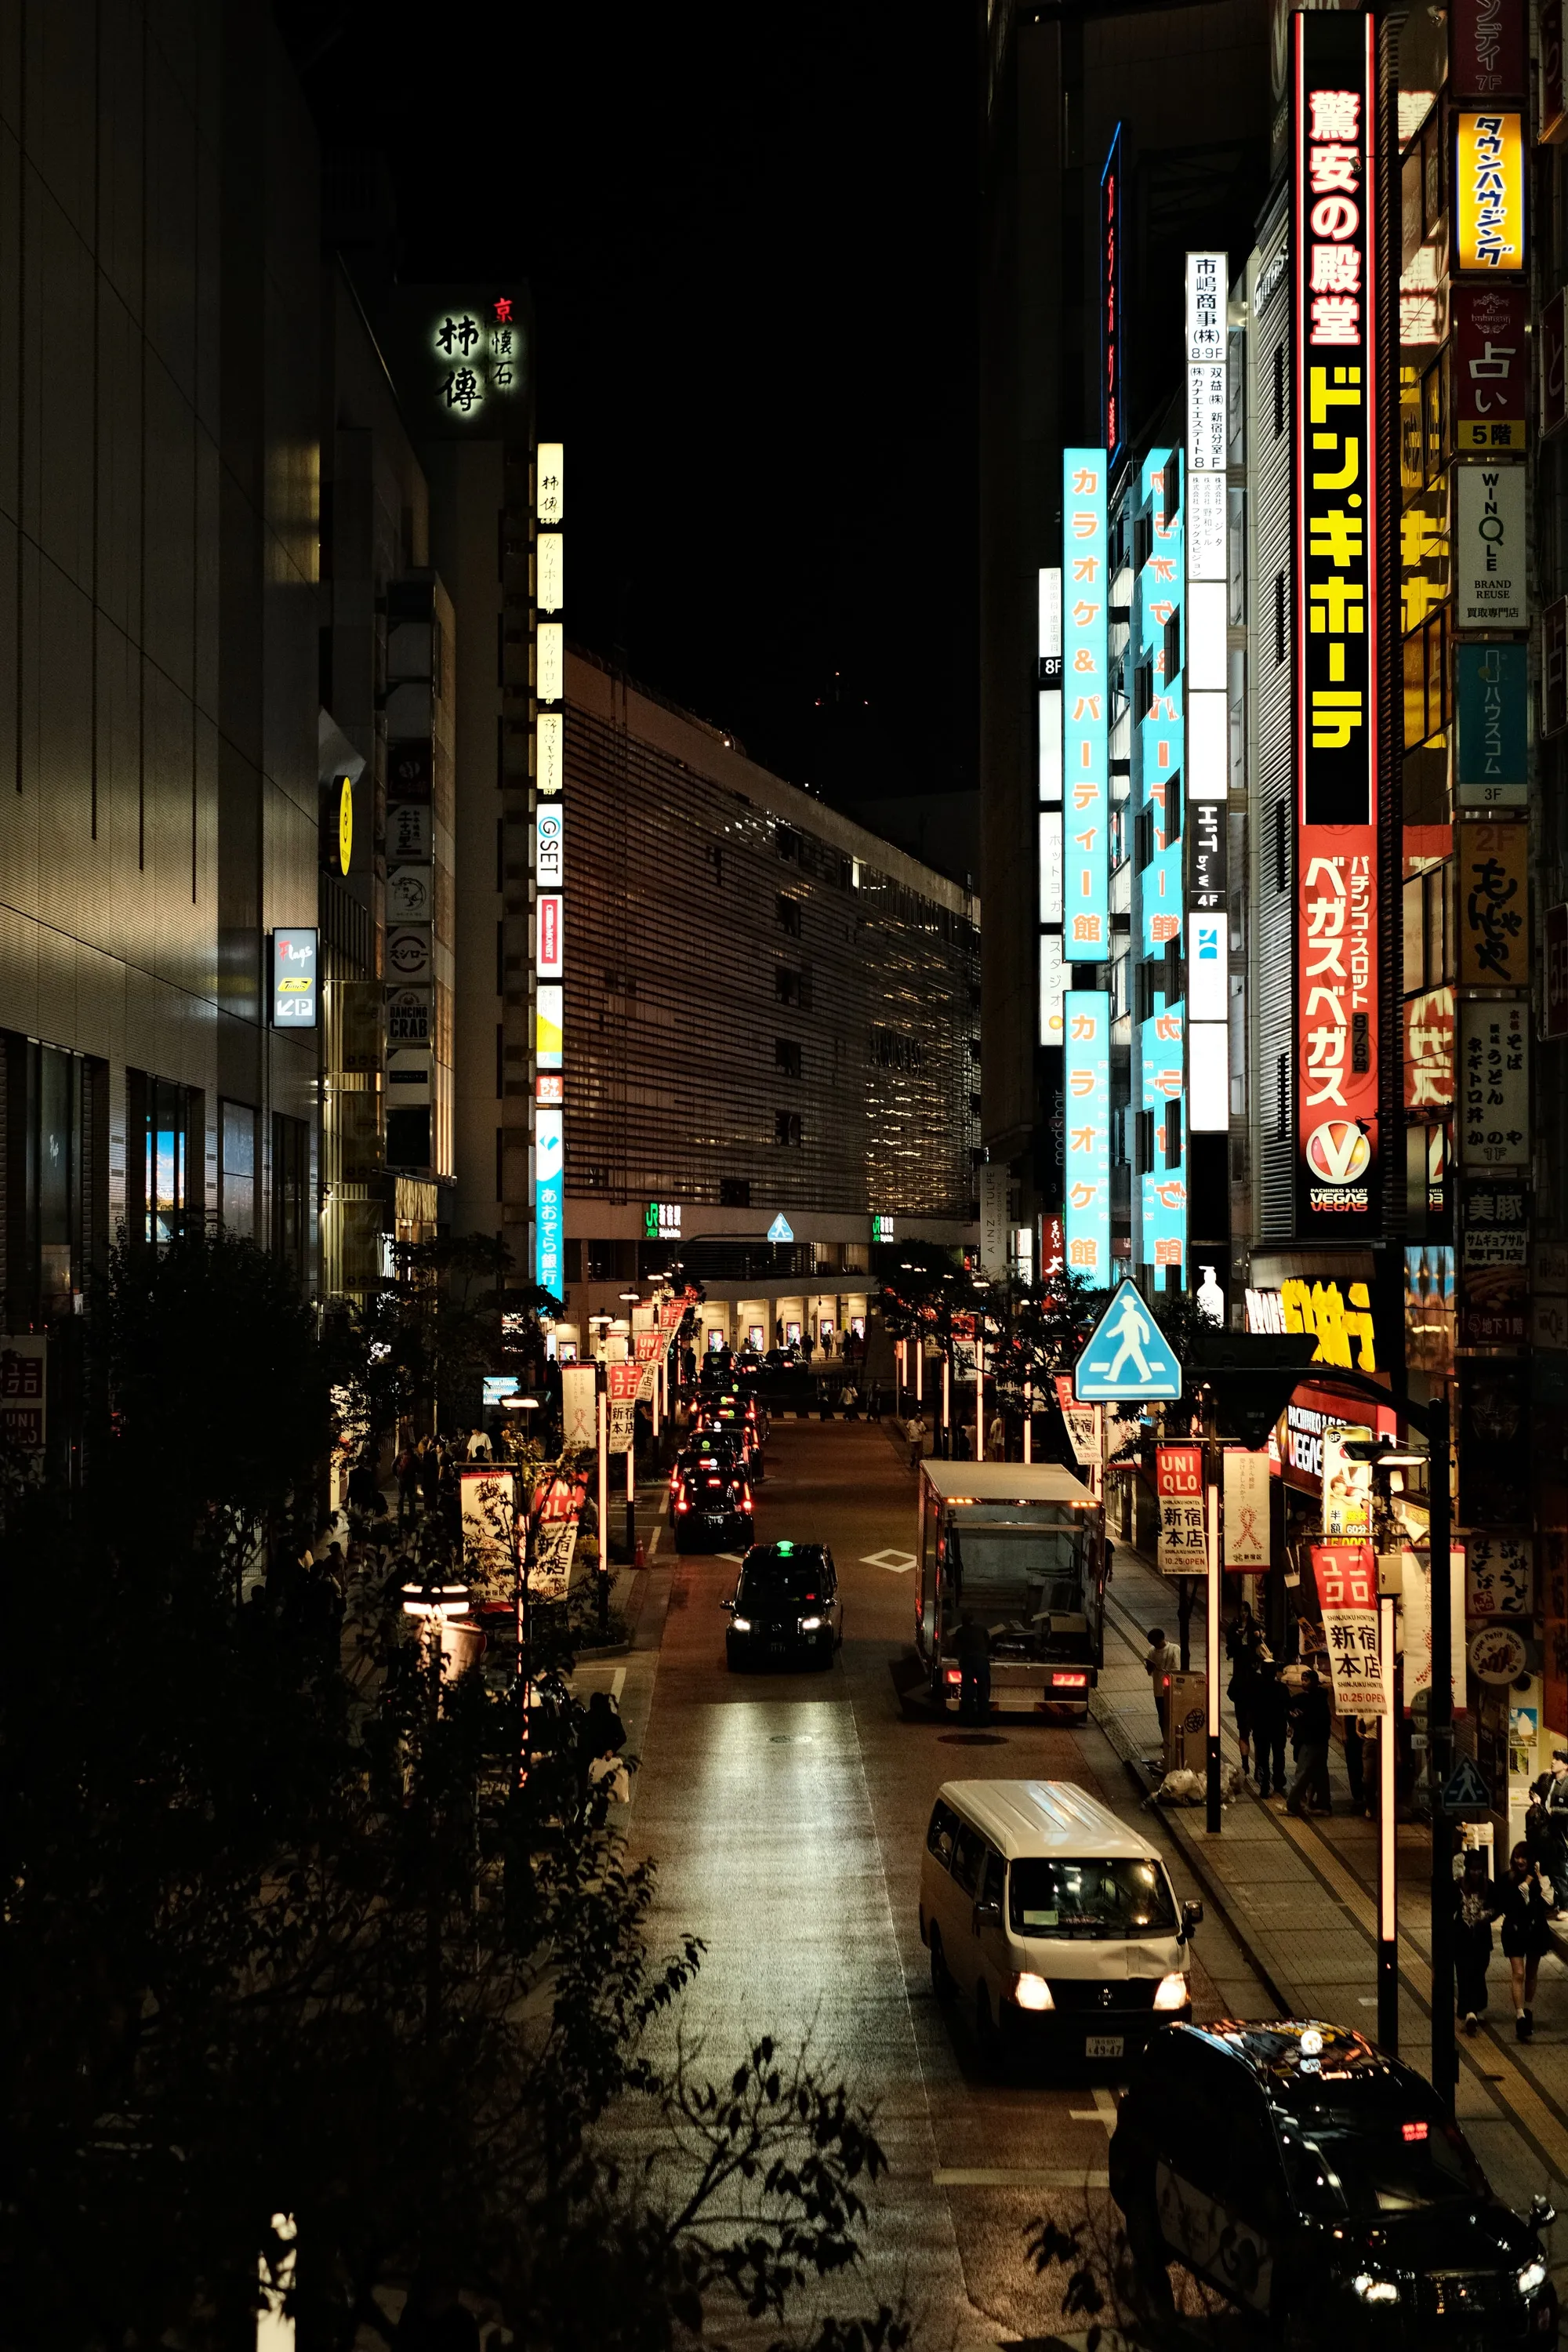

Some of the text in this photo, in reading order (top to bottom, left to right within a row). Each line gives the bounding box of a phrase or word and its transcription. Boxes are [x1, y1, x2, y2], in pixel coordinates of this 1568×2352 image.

[1475, 75, 1502, 90] 7F
[1473, 116, 1515, 267] タウンハウジング
[1309, 89, 1361, 346] 驚安の殿堂
[492, 297, 514, 385] 京懐石
[1468, 341, 1516, 413] 占い
[1210, 412, 1223, 455] 新宿分室
[1472, 423, 1512, 446] 5階
[1479, 474, 1504, 572] WINQLE
[1310, 366, 1363, 749] ドン・キホーテ
[1474, 580, 1512, 590] BRAND
[1476, 590, 1510, 599] REUSE
[1045, 659, 1062, 674] 8F
[1073, 468, 1102, 941] カラオケ&パーティー館
[1483, 686, 1501, 775] ハウスコム
[1484, 789, 1501, 800] 3F
[1475, 825, 1517, 852] 2F
[1049, 833, 1062, 913] ホットヨガ
[1196, 855, 1209, 871] by
[1198, 874, 1209, 887] W
[1197, 895, 1218, 906] 4F
[1350, 856, 1370, 1010] パチンコ・スロット
[278, 940, 313, 968] Flags
[390, 949, 429, 960] スシロー
[1049, 941, 1061, 1007] スタジオ
[1305, 857, 1348, 1106] ベガスベガス
[390, 1007, 427, 1018] DANCING
[390, 1019, 427, 1038] CRAB
[1352, 1014, 1368, 1073] 876台
[1507, 1033, 1522, 1070] そば
[1467, 1036, 1484, 1123] ネギトロ丼
[1487, 1049, 1504, 1105] うどん
[1051, 1090, 1063, 1166] mod's hair
[1468, 1130, 1523, 1146] かのや
[1069, 1014, 1098, 1267] カラオケ館
[1483, 1147, 1507, 1161] 1F
[1310, 1193, 1369, 1203] VEGAS
[1468, 1195, 1523, 1221] 美豚
[646, 1203, 658, 1227] JR
[986, 1172, 995, 1254] AINZ TULPE
[873, 1216, 880, 1234] JR
[541, 1189, 557, 1285] あおぞら銀行
[1481, 1316, 1524, 1334] 地下1階
[7, 1363, 38, 1377] ユニ
[615, 1371, 637, 1382] ユニ
[6, 1380, 37, 1393] クロ
[613, 1384, 637, 1396] クロ
[5, 1413, 35, 1427] UNI
[1068, 1418, 1091, 1432] 新宿
[1288, 1406, 1321, 1435] PACHINKO
[1329, 1433, 1341, 1443] 8F
[1161, 1456, 1193, 1472] UNI
[1163, 1475, 1197, 1494] QLO
[1164, 1508, 1201, 1526] 新宿
[1165, 1529, 1203, 1548] 本店
[1347, 1525, 1367, 1534] 60分
[1322, 1555, 1367, 1577] ユニ
[1326, 1581, 1369, 1602] クロ
[1330, 1624, 1375, 1650] 新宿
[1335, 1653, 1381, 1679] 本店
[1338, 1693, 1363, 1703] 10.25
